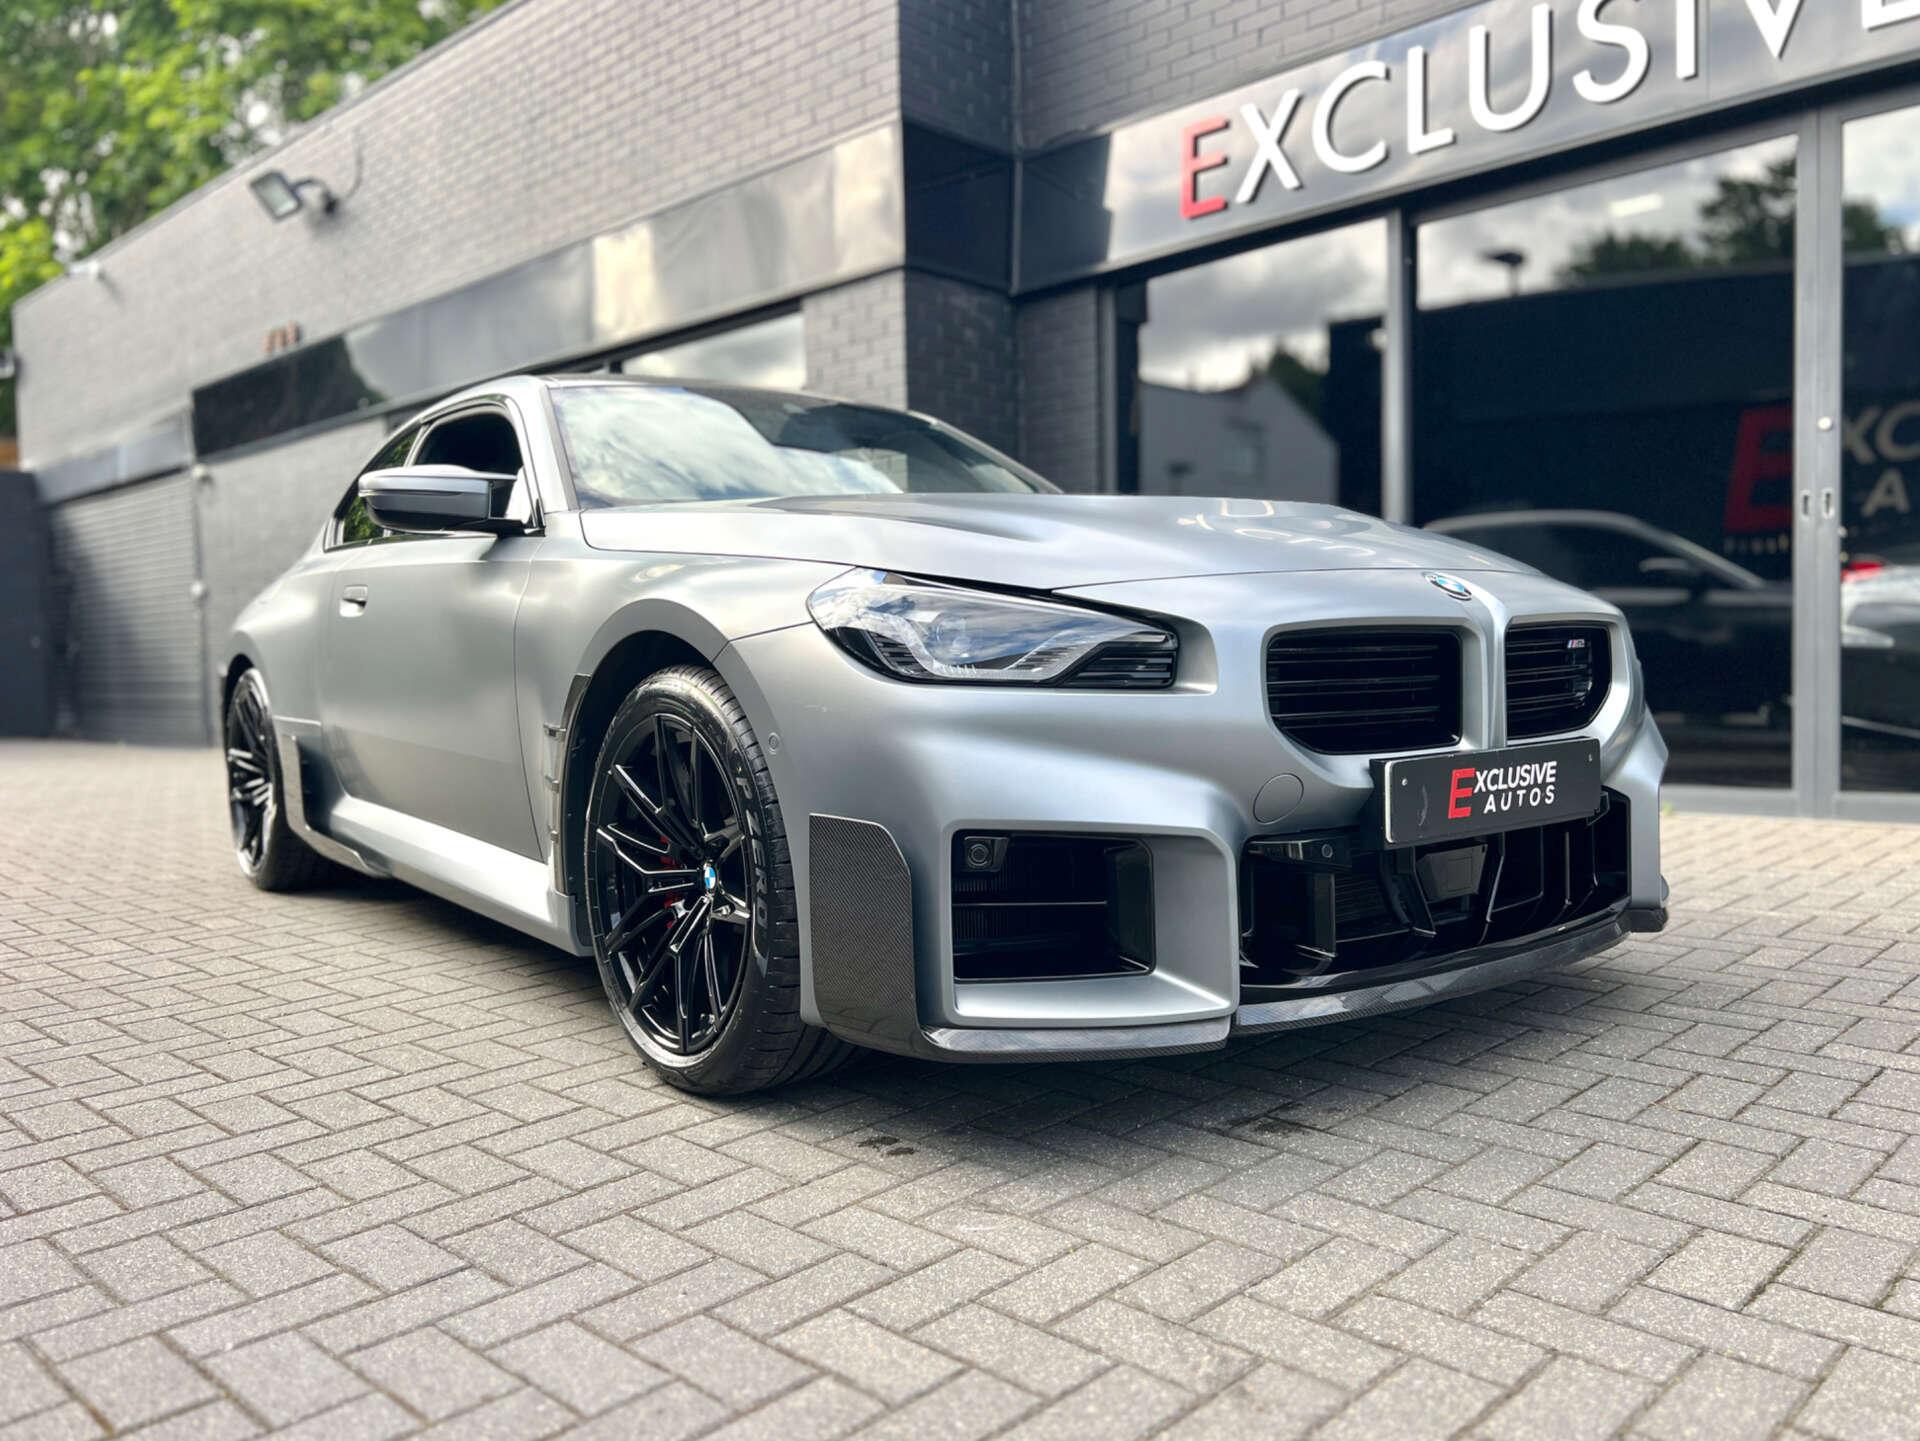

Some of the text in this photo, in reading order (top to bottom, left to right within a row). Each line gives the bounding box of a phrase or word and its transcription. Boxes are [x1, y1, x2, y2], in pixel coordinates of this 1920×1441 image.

[1180, 0, 1920, 219] EXCLUSIV
[1448, 761, 1557, 819] EXCLUSIVE
[1483, 785, 1555, 814] AUTOS
